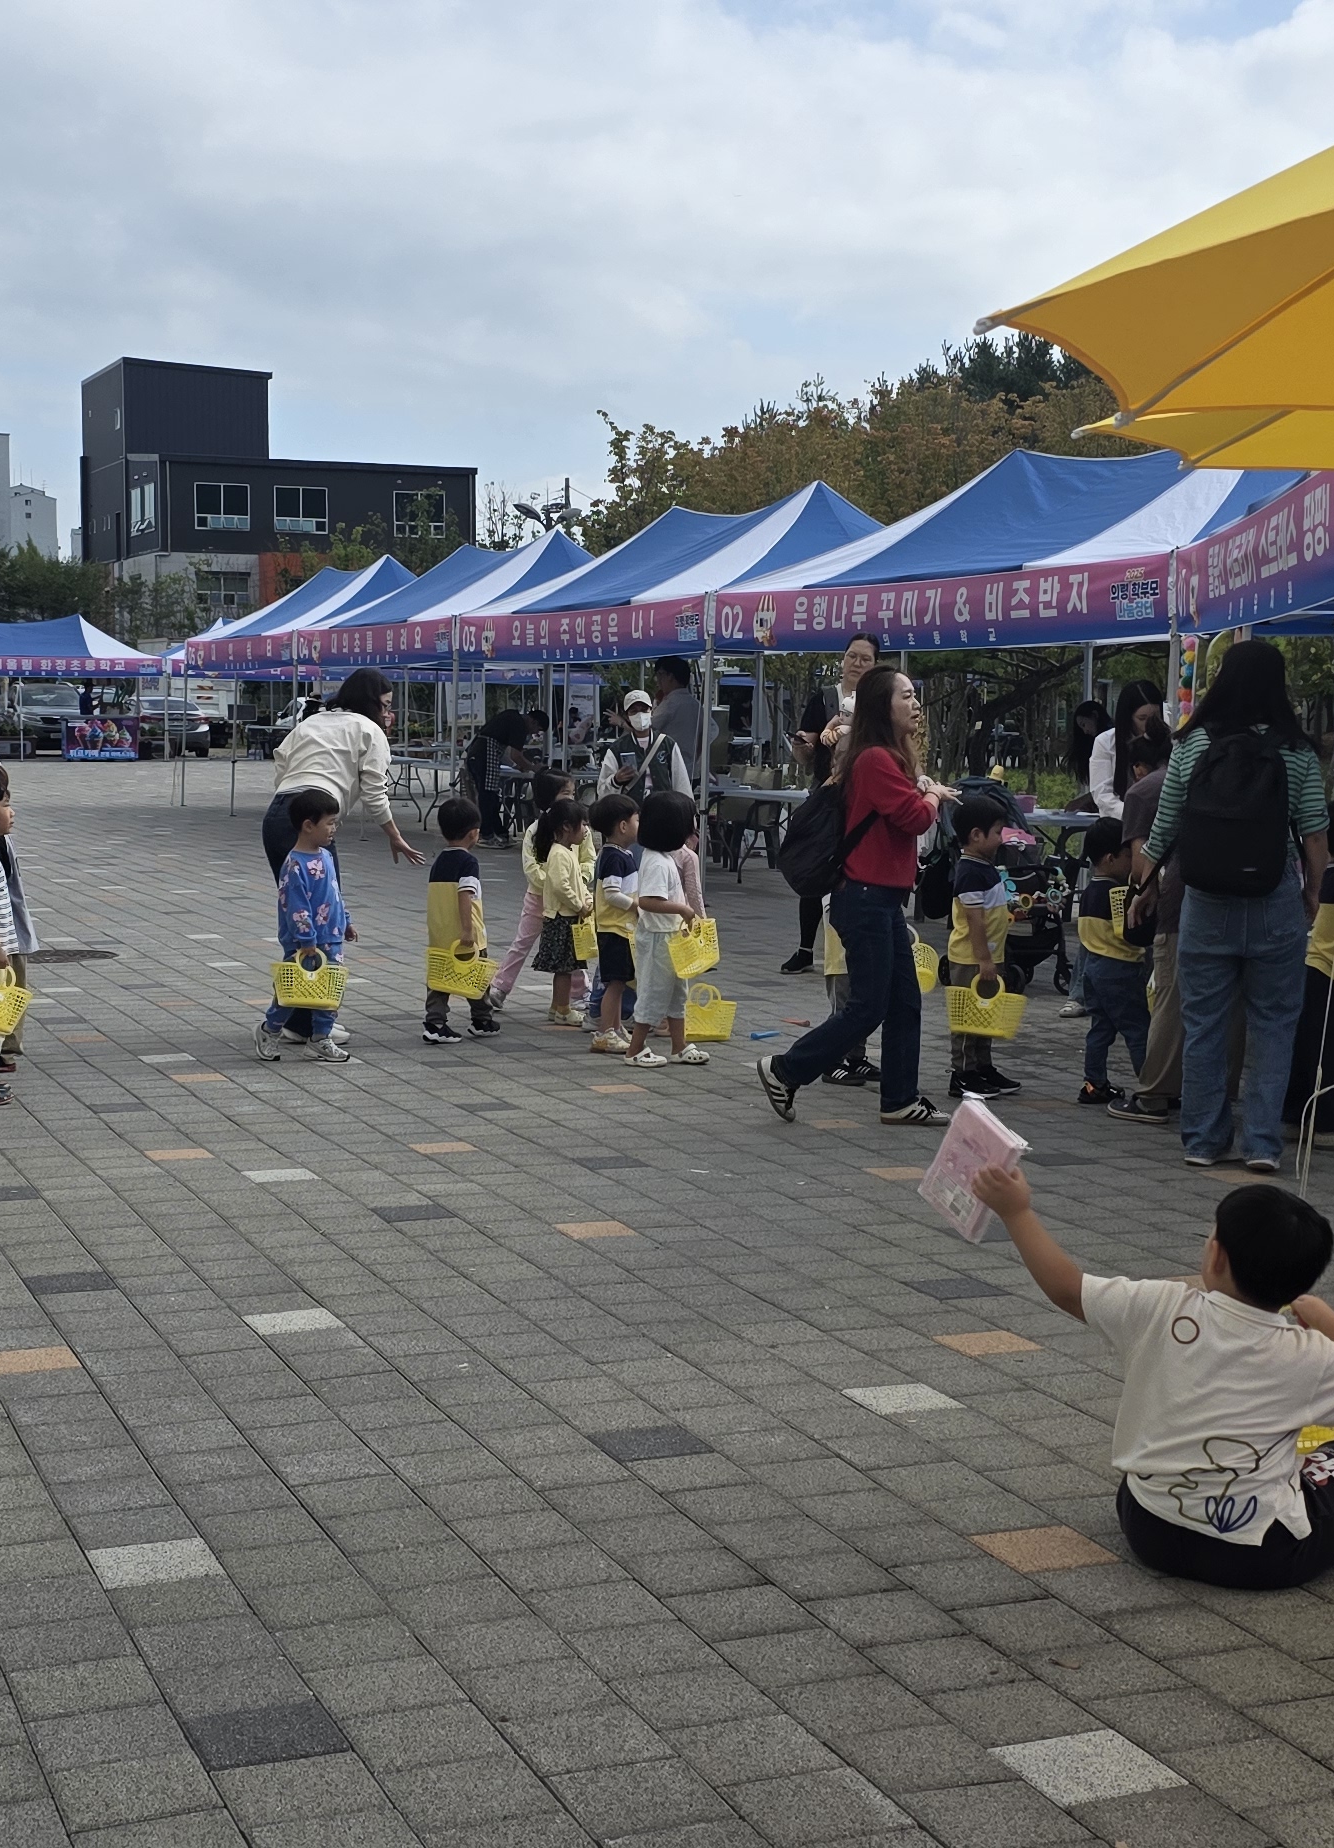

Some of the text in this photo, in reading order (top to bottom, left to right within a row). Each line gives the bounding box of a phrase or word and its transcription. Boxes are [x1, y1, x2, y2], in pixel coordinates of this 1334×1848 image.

[793, 572, 1090, 631] 은행나무 꾸미기 & 비즈반지
[1110, 579, 1160, 602] 의령 학부모
[512, 619, 549, 647] 오늘의
[560, 612, 619, 646] 주인공은
[721, 605, 744, 639] 02
[463, 626, 476, 652] 03
[883, 627, 997, 646] 의초등학교
[40, 659, 126, 672] 화정초등학교
